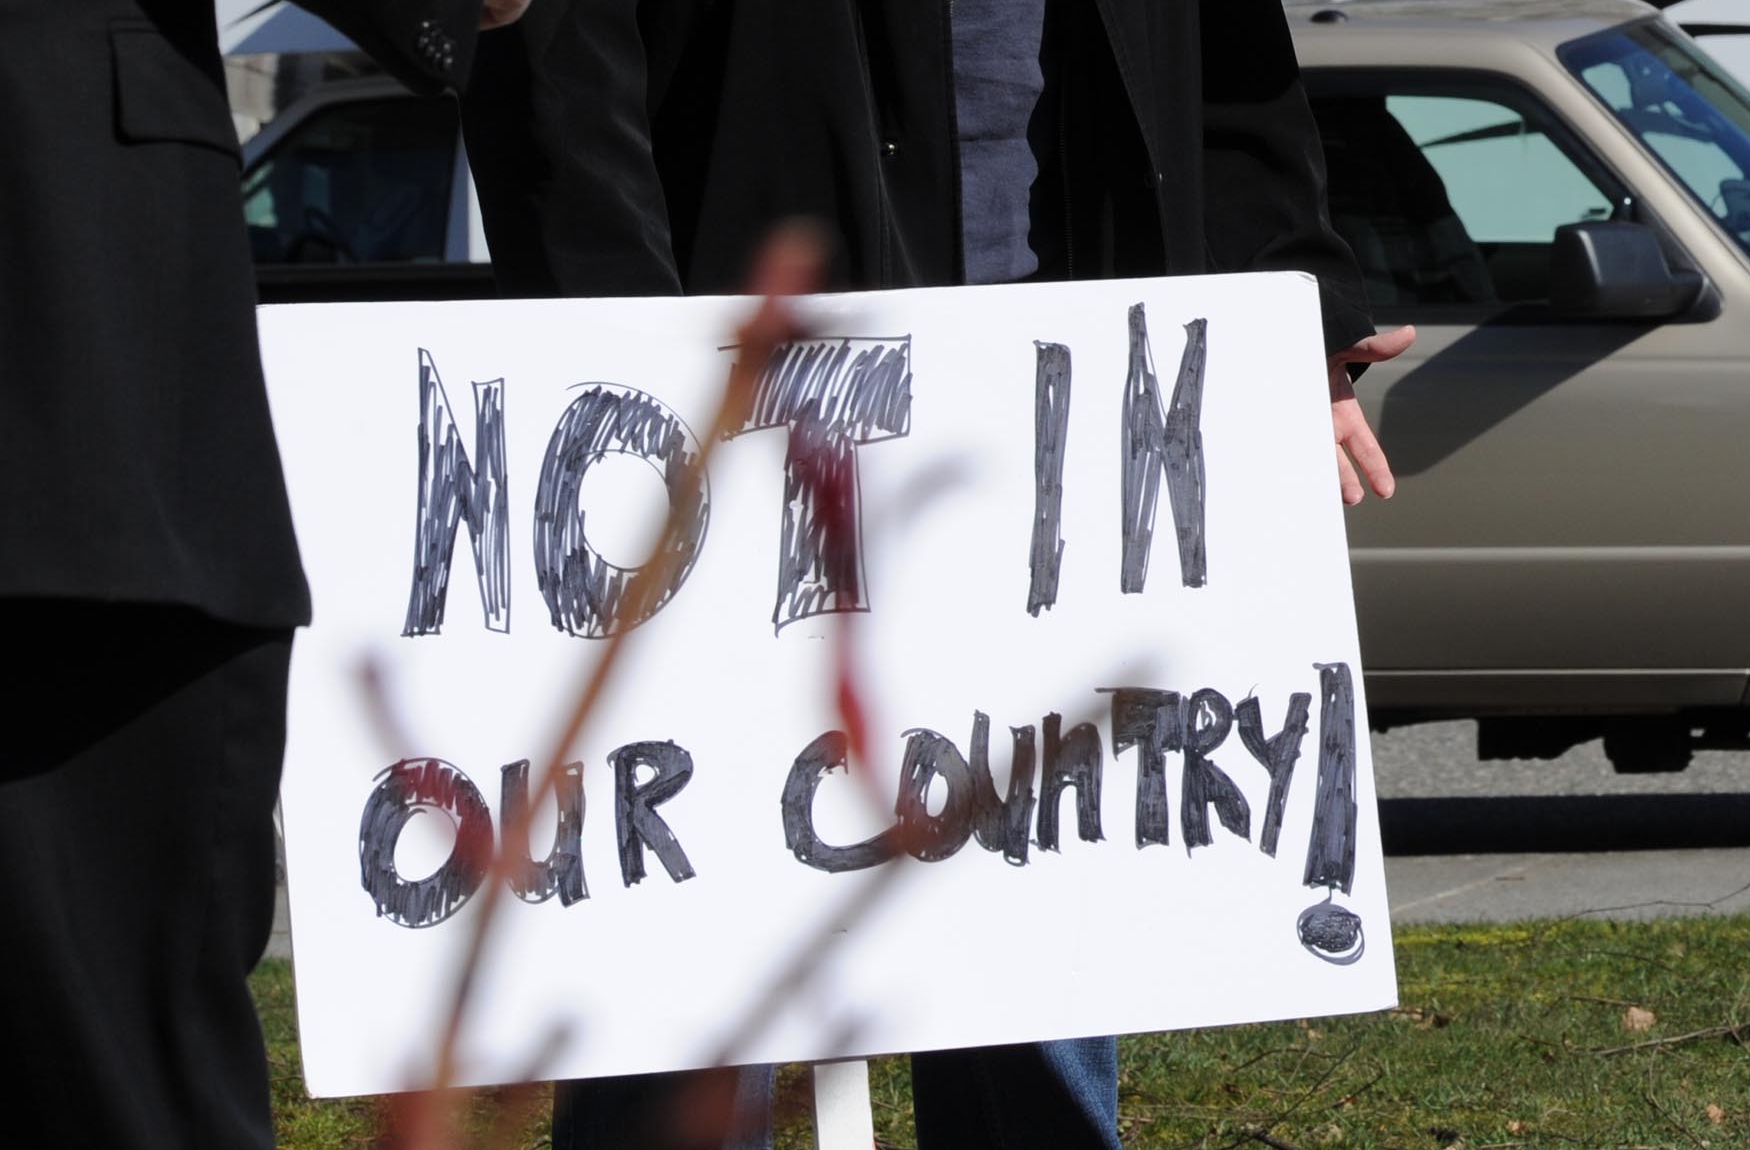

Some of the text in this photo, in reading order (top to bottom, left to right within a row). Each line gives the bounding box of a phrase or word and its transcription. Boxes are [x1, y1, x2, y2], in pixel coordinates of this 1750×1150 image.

[401, 302, 1208, 638] NOT IN
[359, 738, 695, 928] OUR
